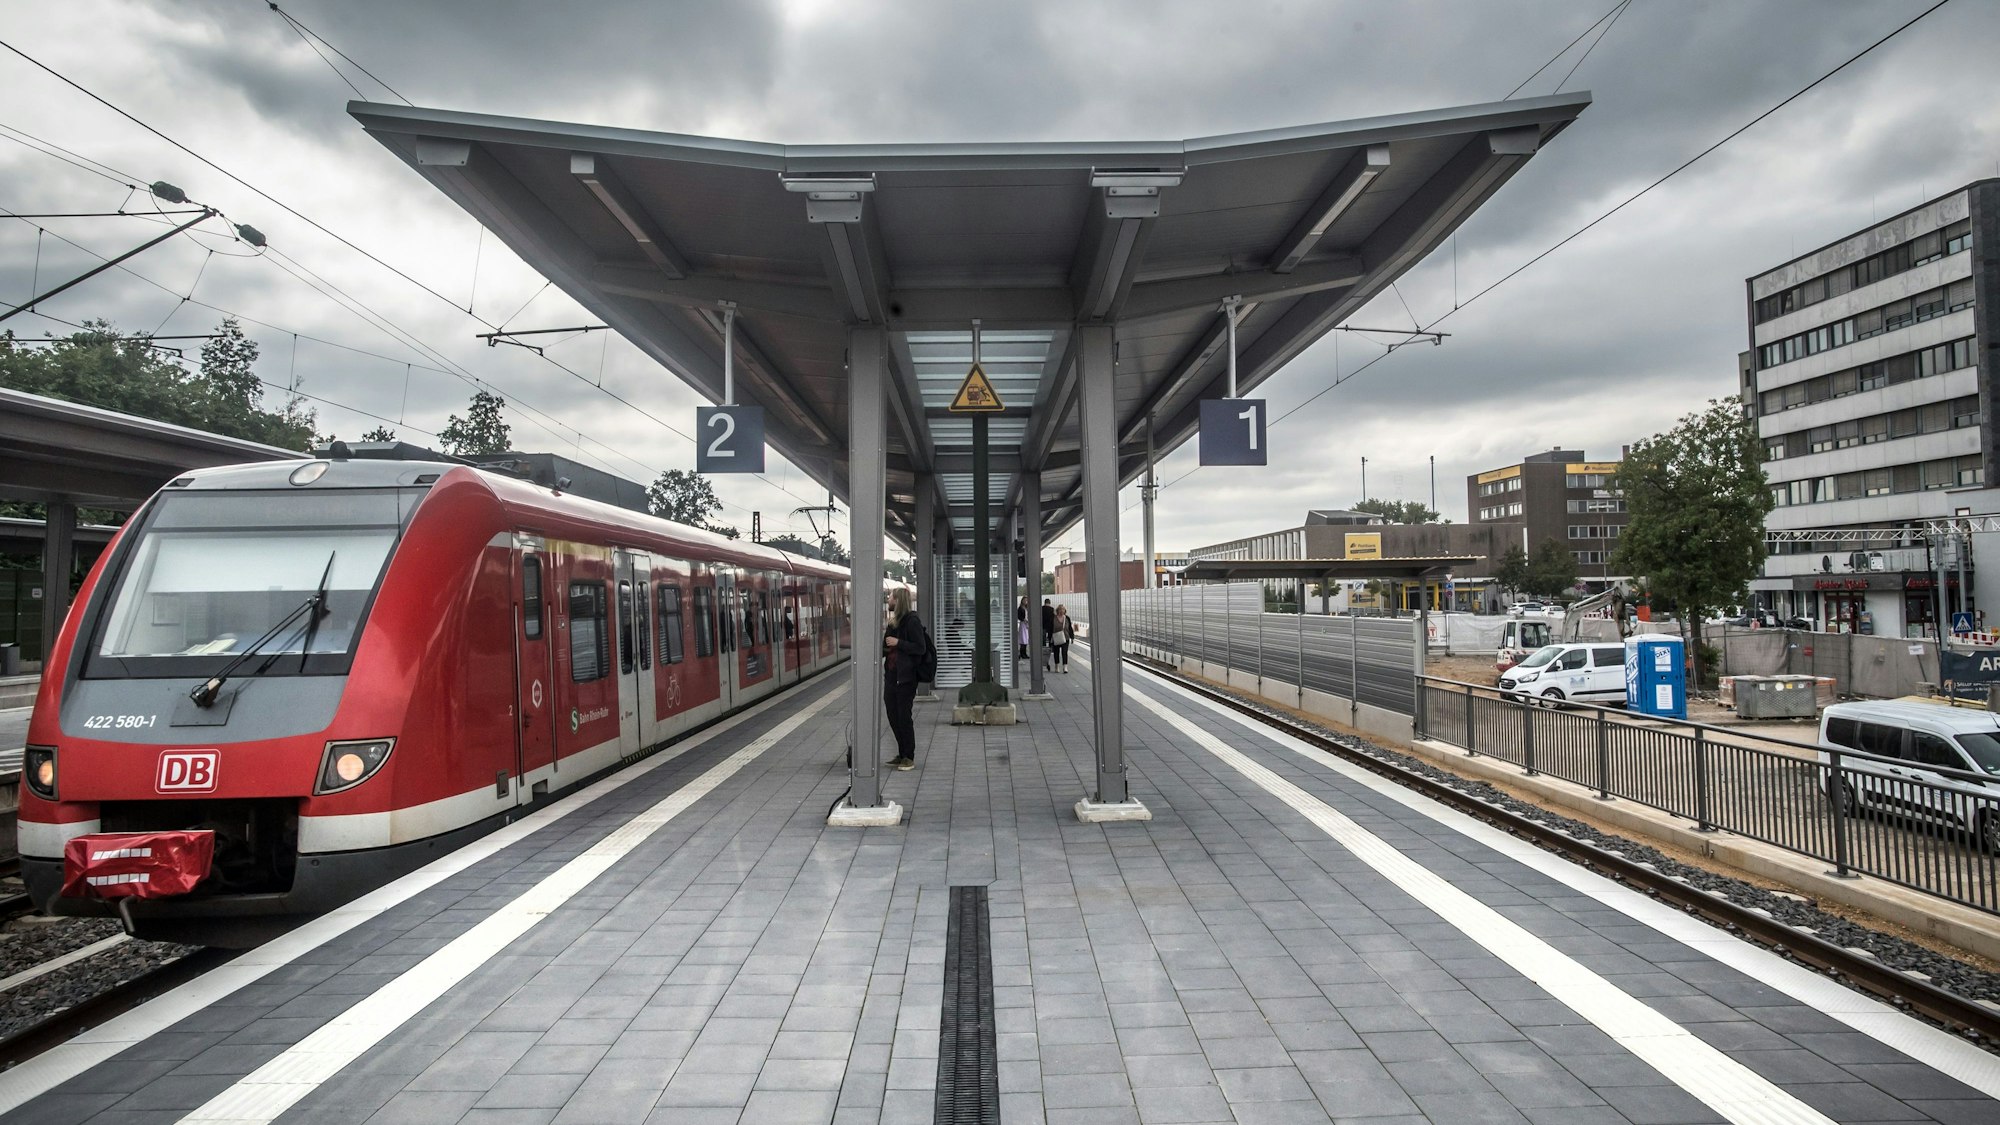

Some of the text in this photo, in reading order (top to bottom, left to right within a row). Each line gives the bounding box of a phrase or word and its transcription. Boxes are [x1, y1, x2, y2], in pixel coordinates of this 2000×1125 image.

[706, 412, 735, 457] 2
[1238, 405, 1258, 450] 1
[83, 715, 157, 729] 422 580-1
[508, 704, 513, 717] 2
[164, 757, 211, 786] DB
